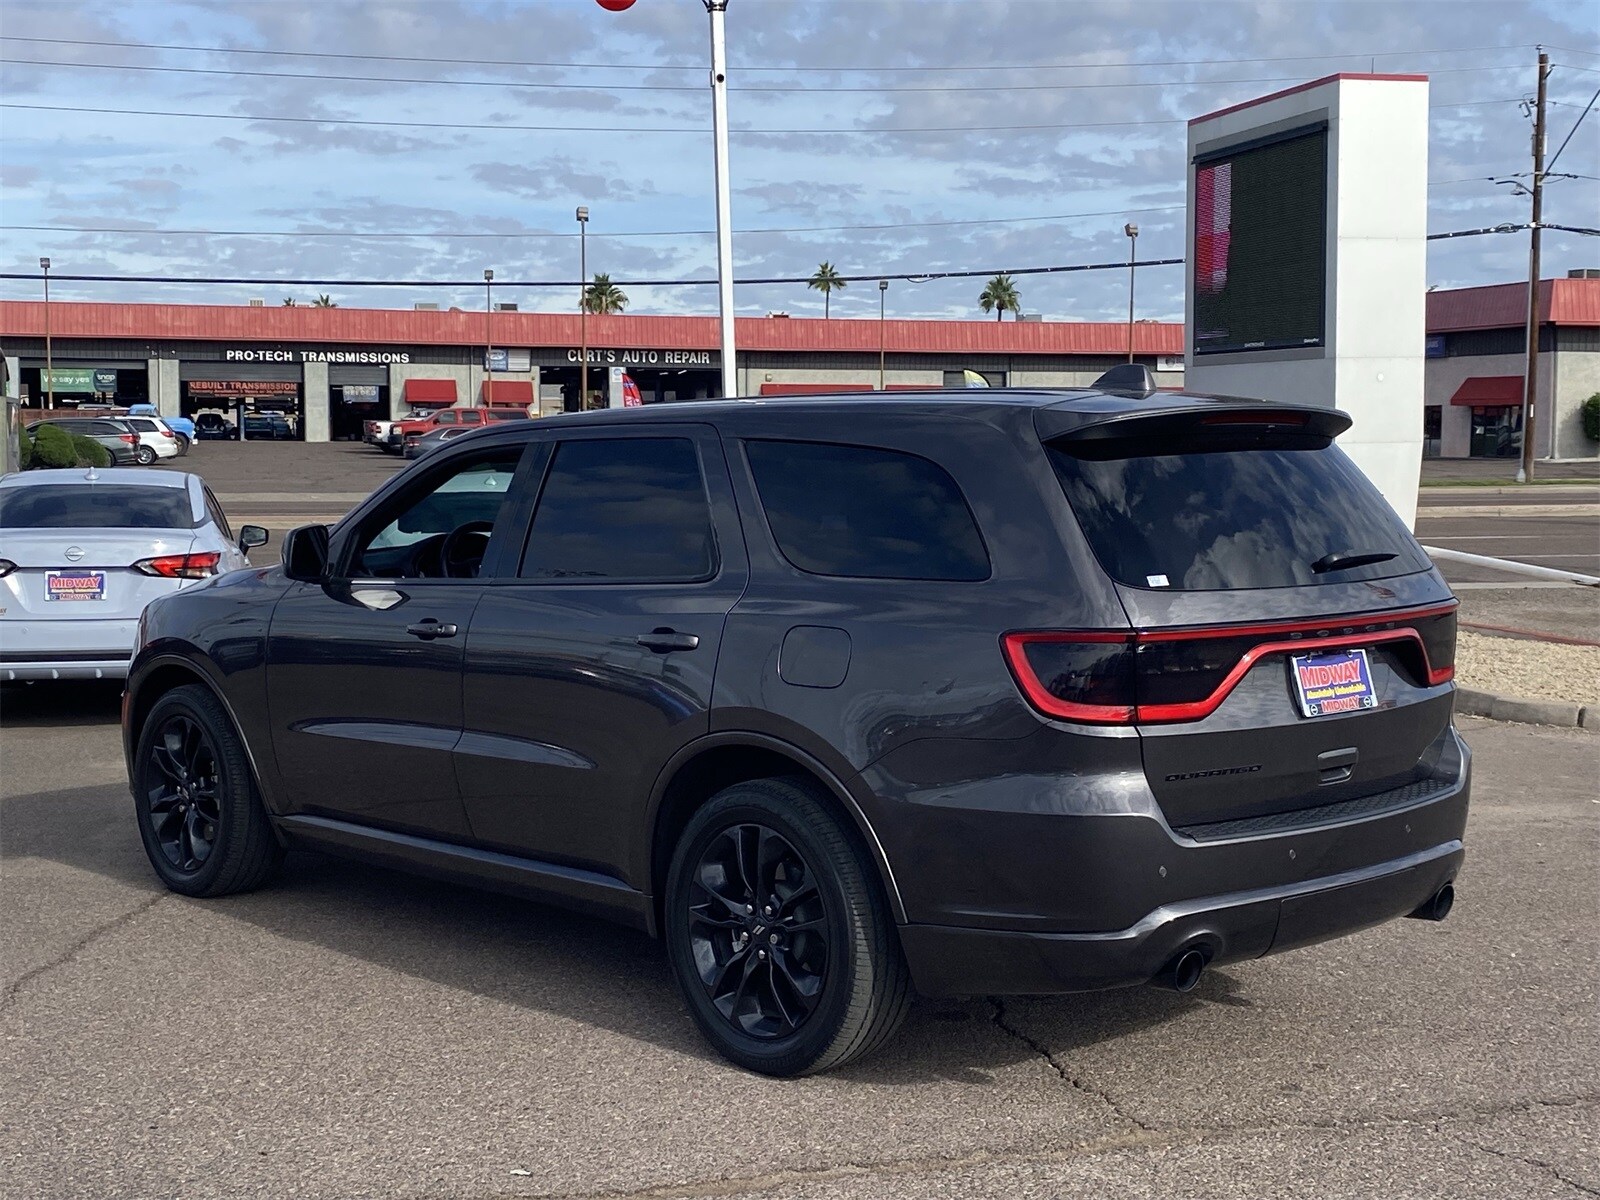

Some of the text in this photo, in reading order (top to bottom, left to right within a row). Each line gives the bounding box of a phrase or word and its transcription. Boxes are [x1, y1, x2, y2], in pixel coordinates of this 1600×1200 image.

[226, 350, 410, 364] PRO-TECH TRANSMISSIONS
[567, 349, 710, 364] CURT'S AUTO REPAIR
[189, 381, 297, 390] REBUILT TRANSMISSION
[50, 577, 101, 588] MIDWAY
[1299, 658, 1361, 690] MIDWAY
[1321, 695, 1359, 713] MIDWAY
[1165, 764, 1262, 782] DURANGO
